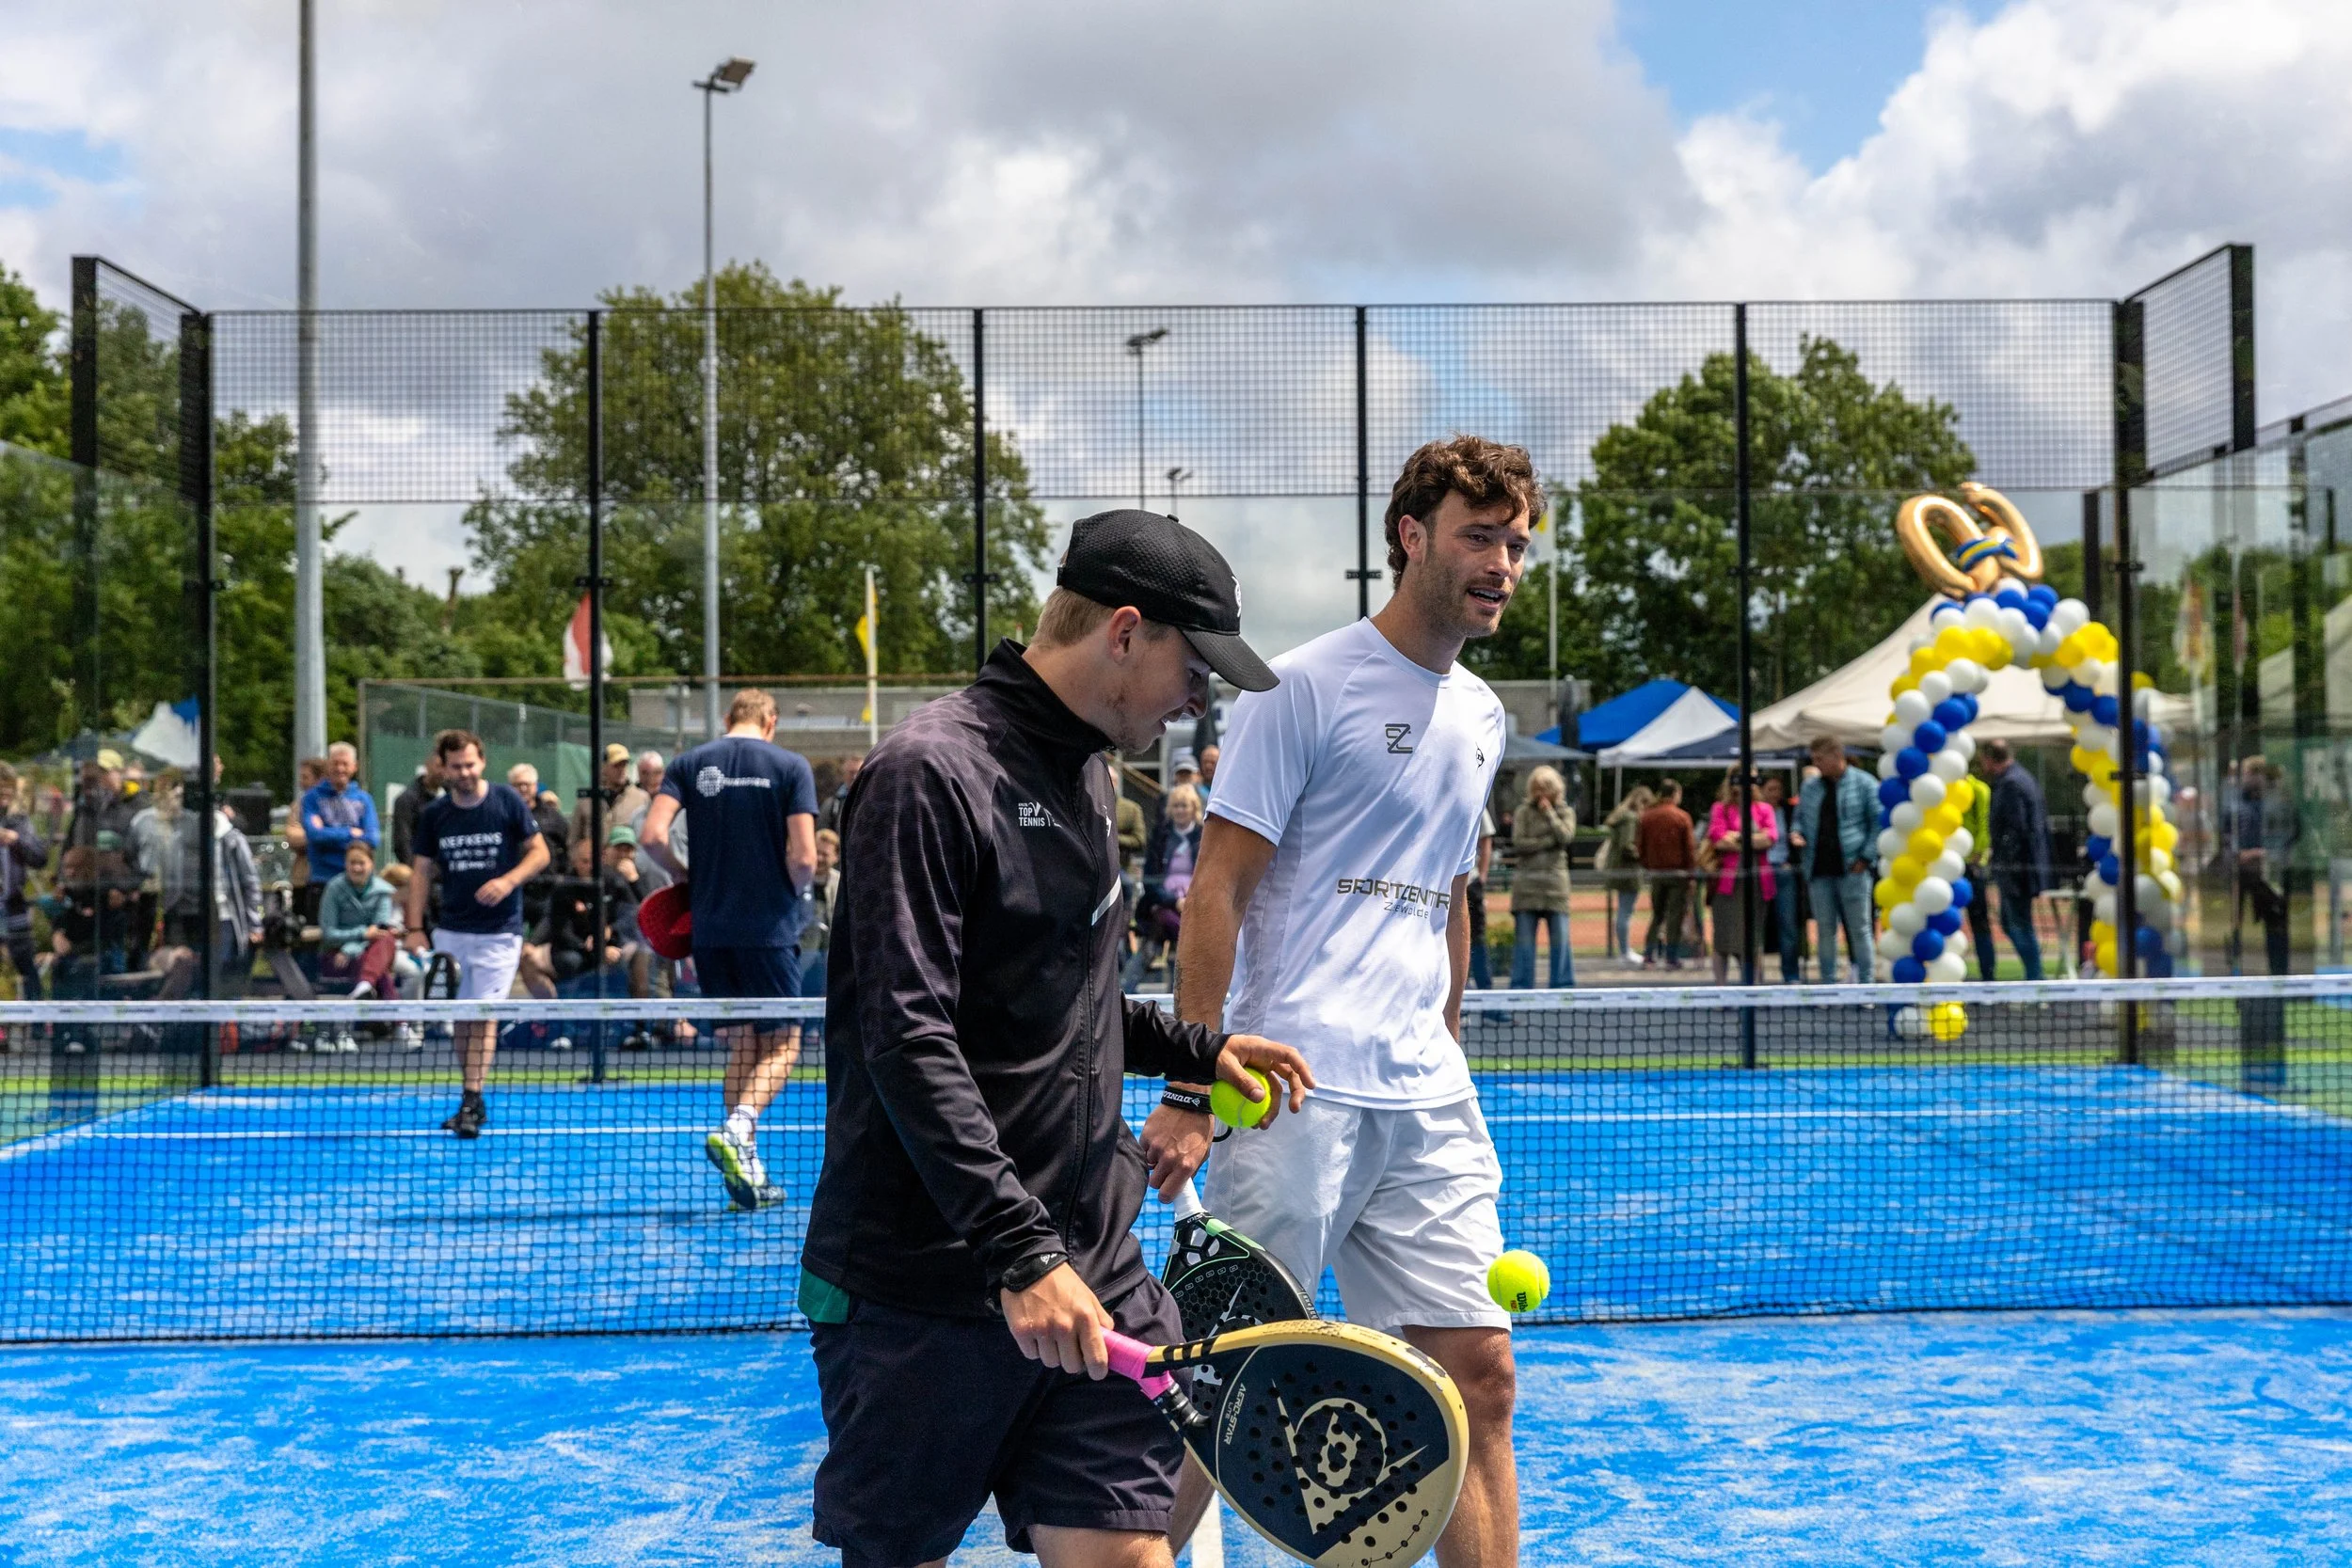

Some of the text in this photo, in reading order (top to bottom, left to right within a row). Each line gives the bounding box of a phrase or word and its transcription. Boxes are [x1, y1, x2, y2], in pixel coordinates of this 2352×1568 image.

[1018, 807, 1033, 816] TOP
[1018, 816, 1046, 827] TENNIS
[1223, 1383, 1247, 1446] AERO-STAR
